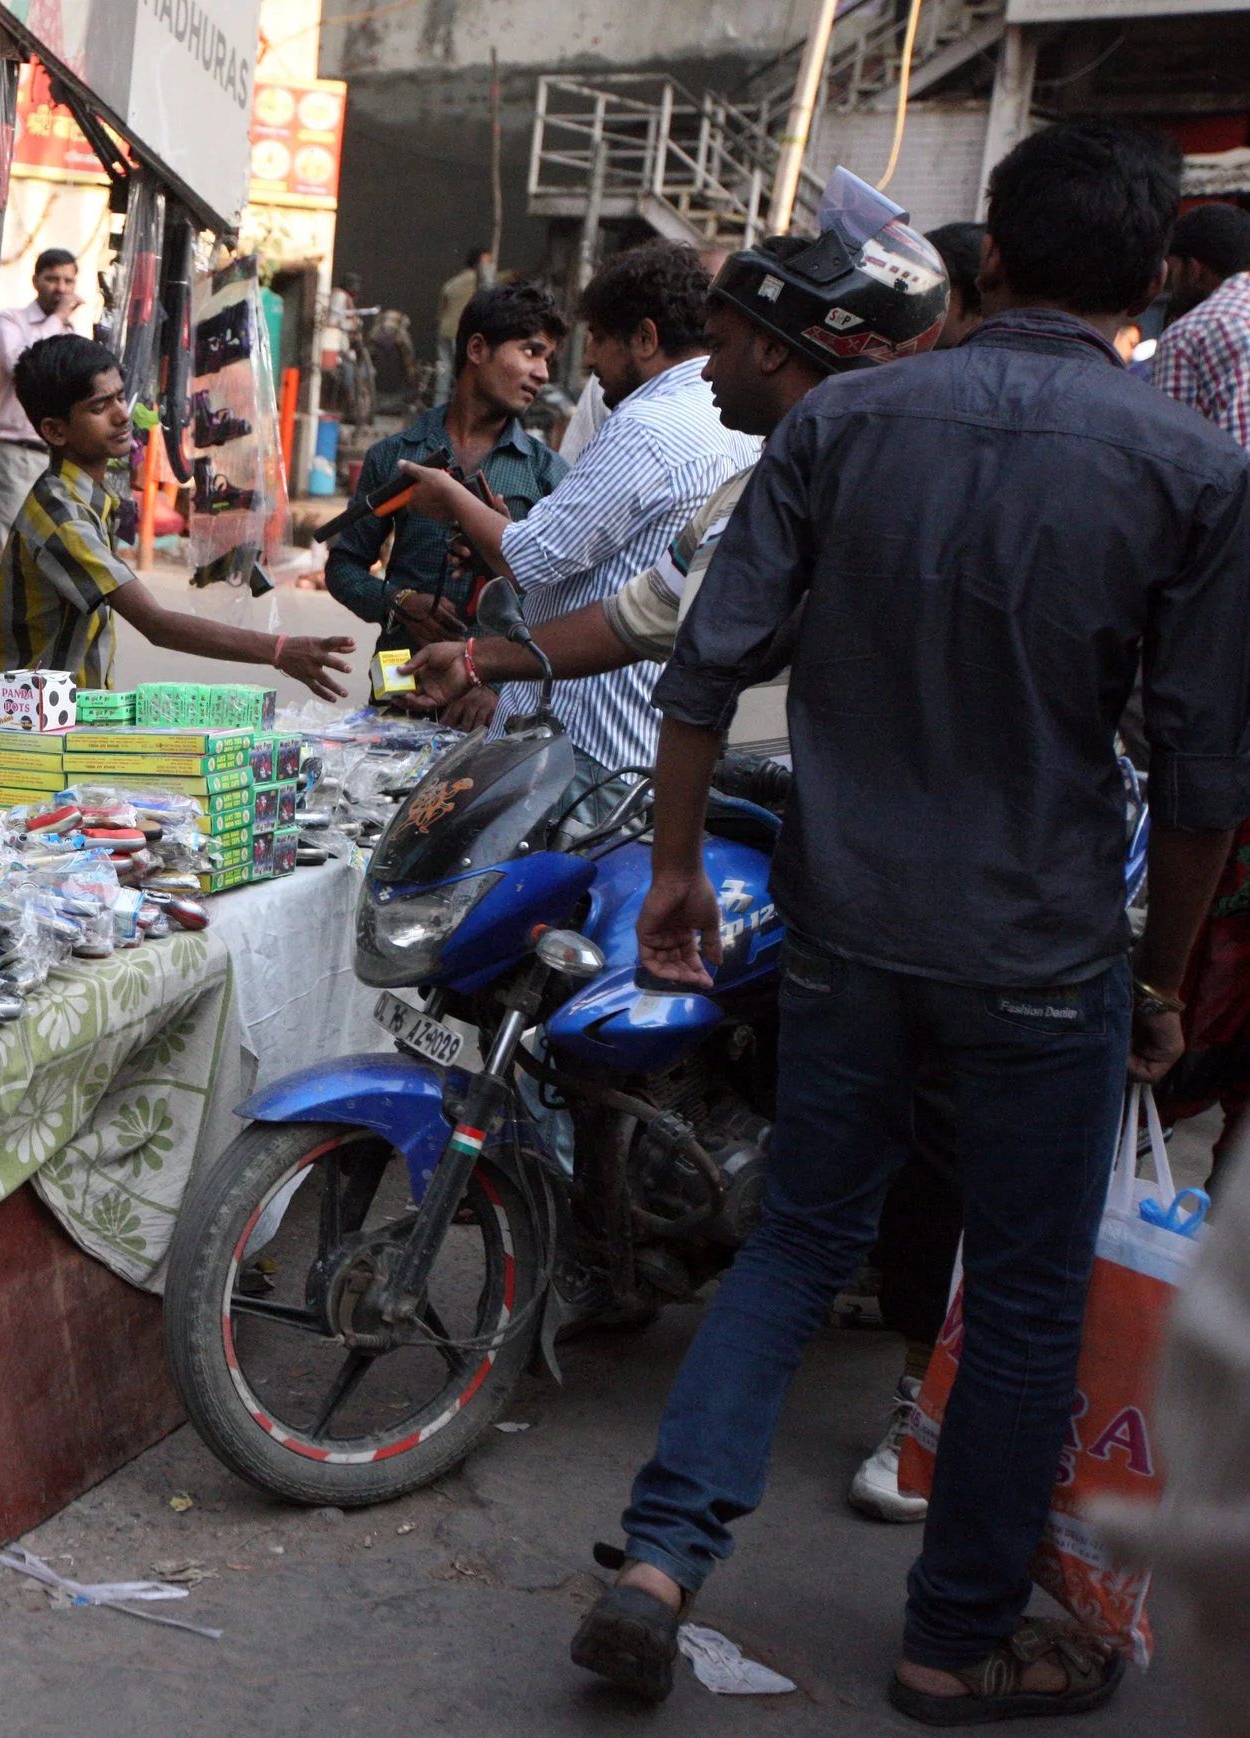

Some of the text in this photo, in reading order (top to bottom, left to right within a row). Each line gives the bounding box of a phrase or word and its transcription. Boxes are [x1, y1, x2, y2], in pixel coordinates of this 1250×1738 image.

[143, 0, 249, 109] ADHURAS
[1, 687, 34, 700] PANDA
[5, 702, 30, 713] POTS
[750, 903, 778, 930] 12
[1000, 1000, 1043, 1017] Fashion
